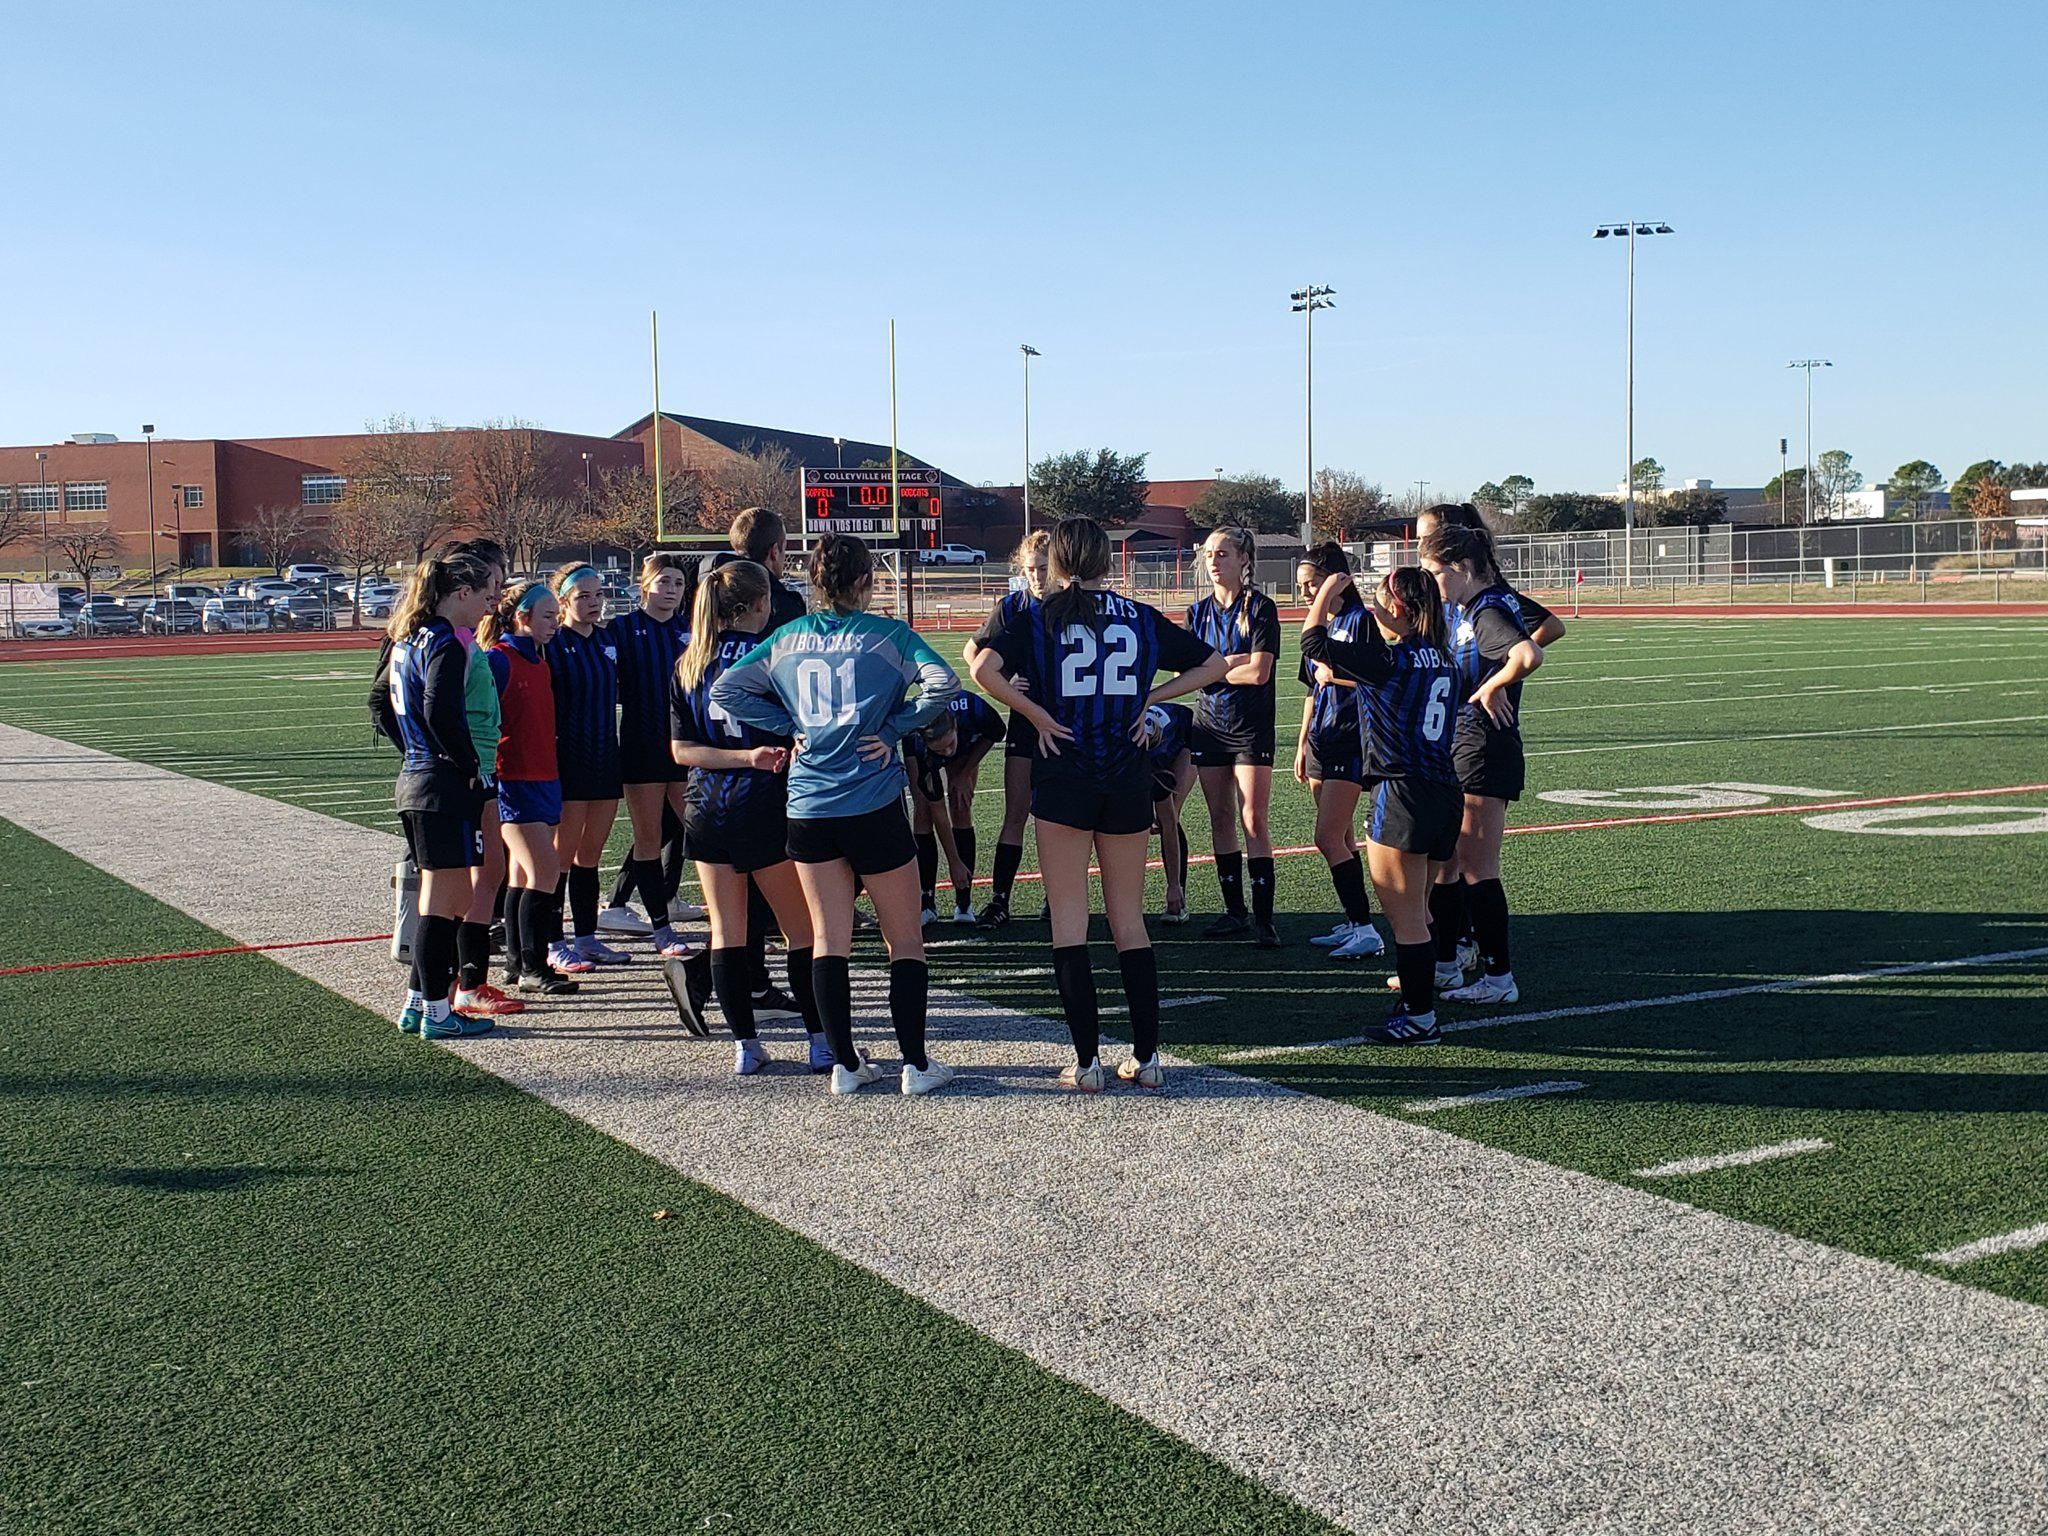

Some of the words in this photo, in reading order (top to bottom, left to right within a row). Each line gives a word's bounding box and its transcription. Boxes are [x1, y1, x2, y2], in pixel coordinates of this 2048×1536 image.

[824, 472, 879, 480] COLLEYVILLE
[881, 472, 922, 480] HEITAGE
[818, 498, 828, 517] 0
[930, 498, 940, 516] 0
[808, 519, 831, 531] DOWN
[836, 519, 850, 531] YDS
[852, 519, 861, 531] TO
[863, 519, 873, 531] GO
[900, 519, 910, 531] ON
[921, 518, 936, 531] QTR
[1060, 623, 1138, 697] 22
[389, 642, 407, 716] 5
[797, 658, 861, 727] 01
[1422, 676, 1451, 742] 6
[475, 830, 483, 854] 5
